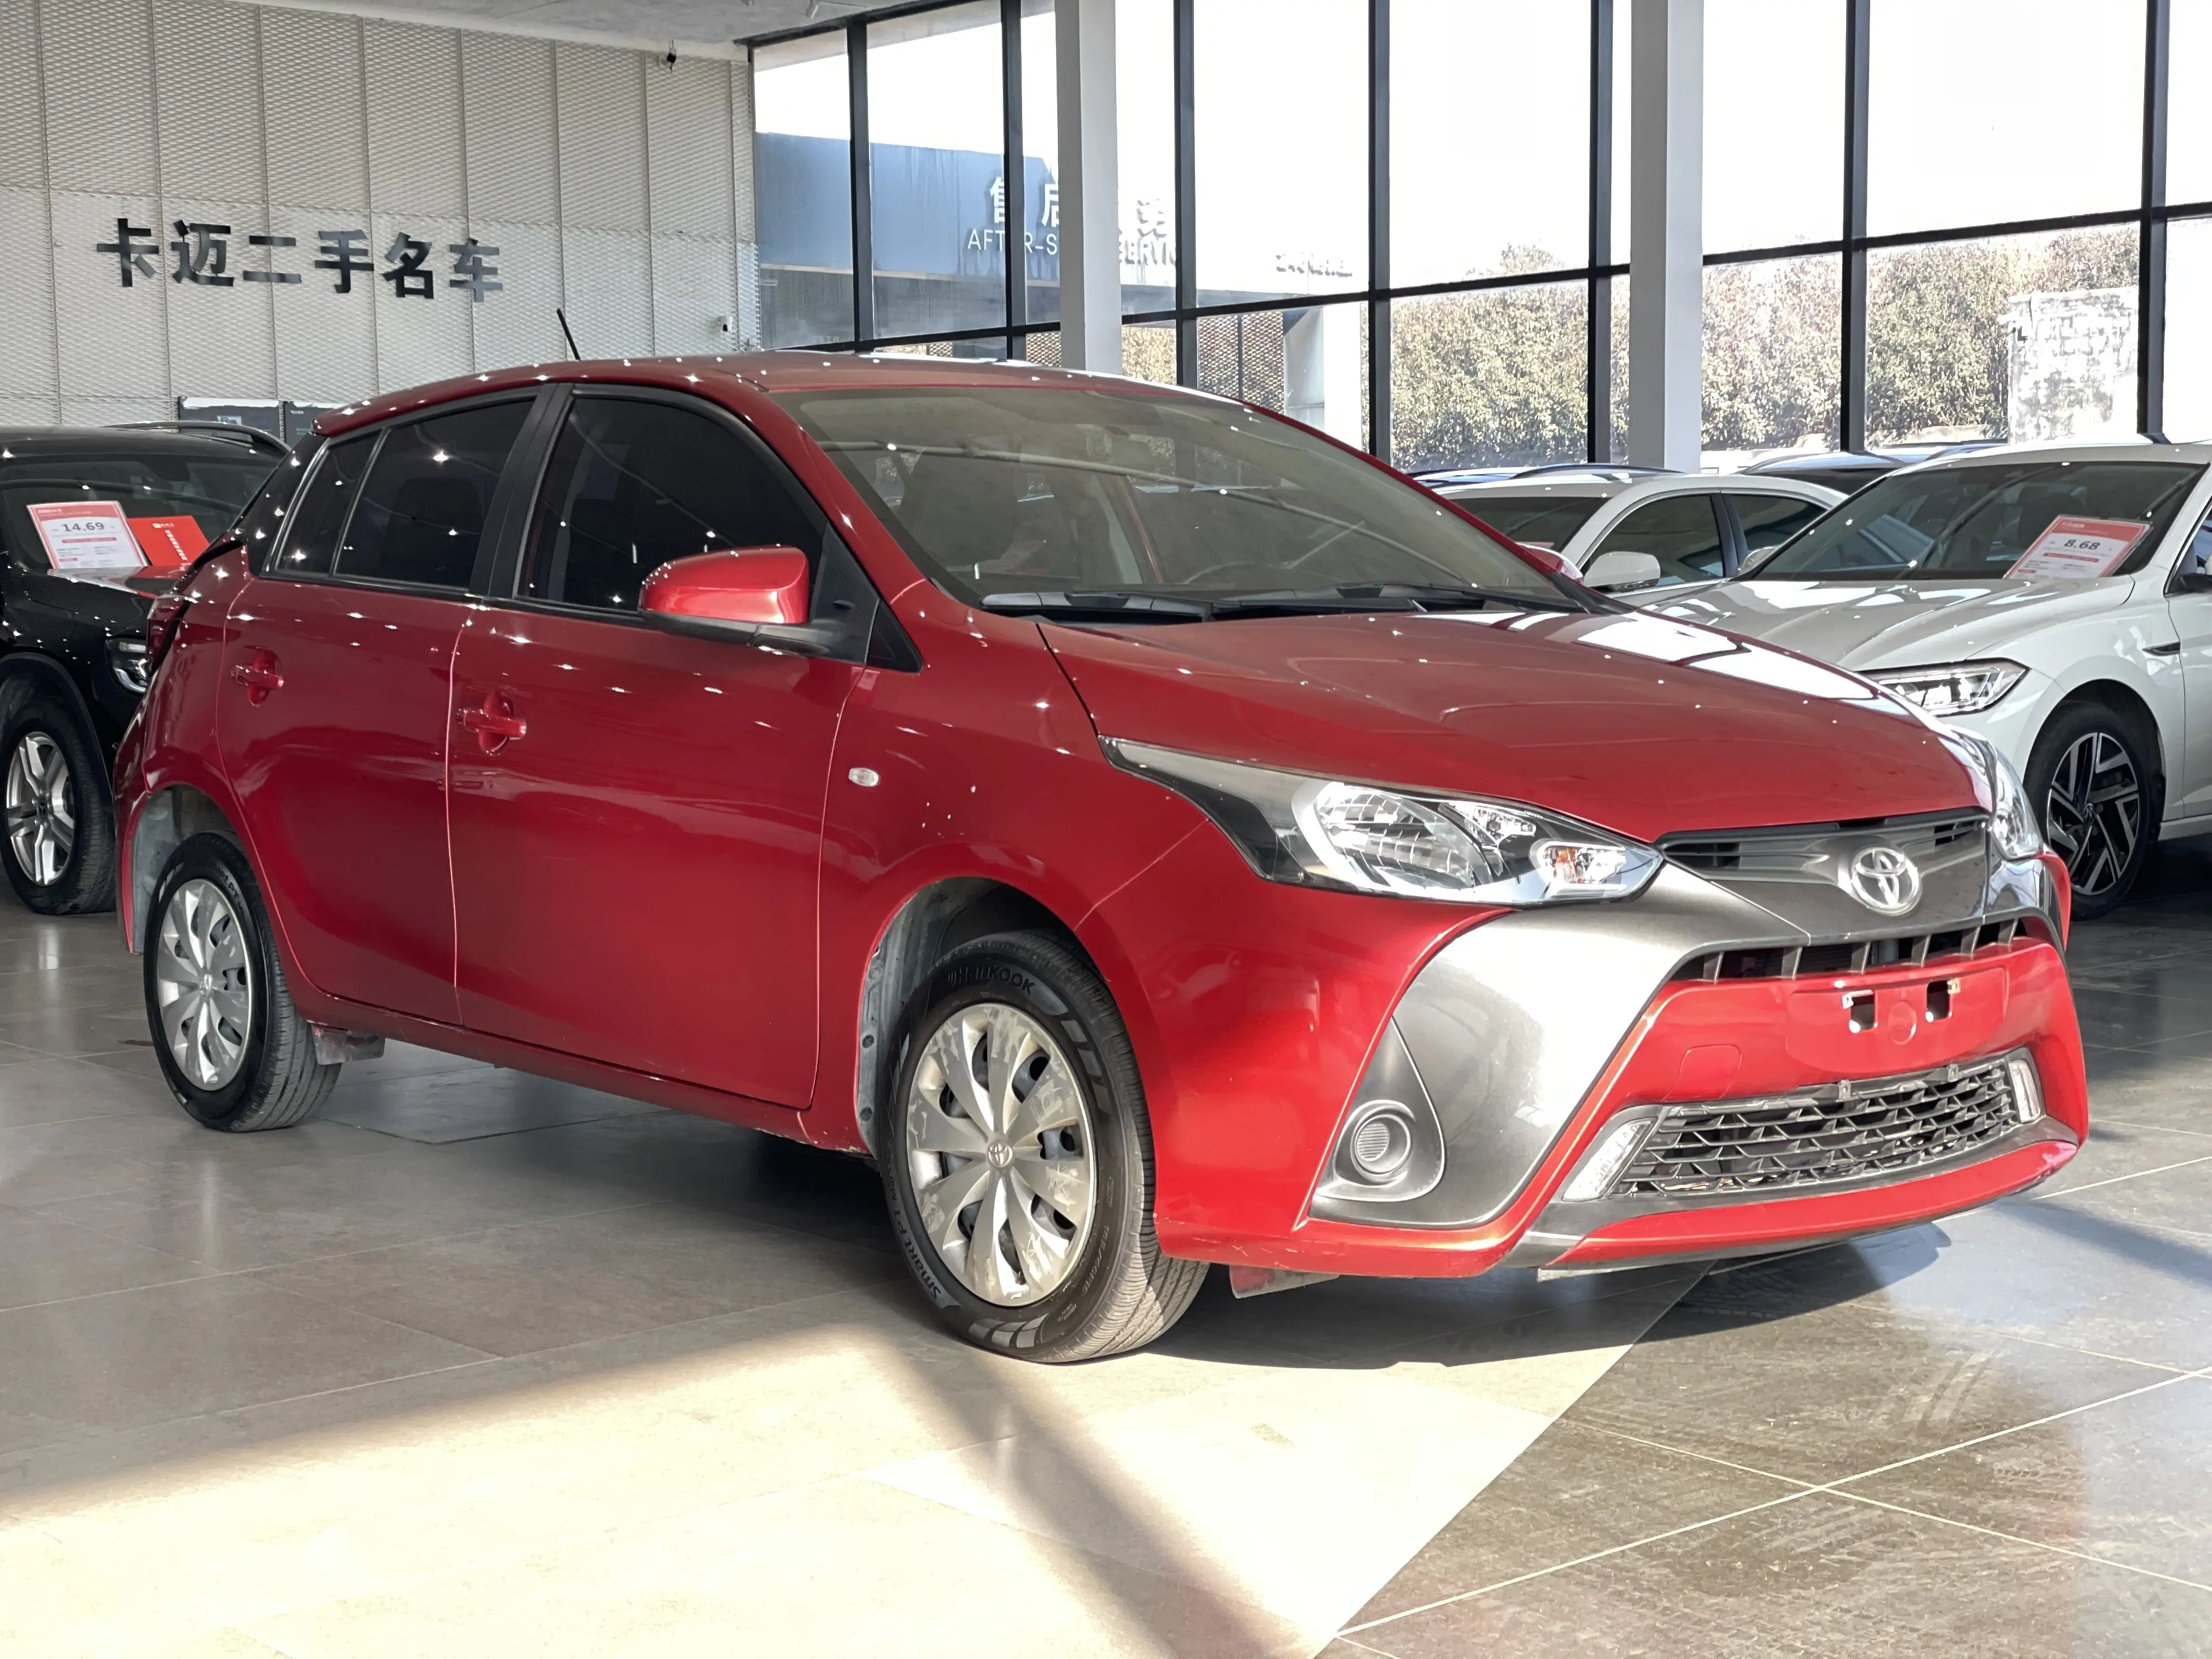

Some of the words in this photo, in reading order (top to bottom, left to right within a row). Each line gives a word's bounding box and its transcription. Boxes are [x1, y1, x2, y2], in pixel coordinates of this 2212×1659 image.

[97, 218, 503, 302] 卡迈二手名车
[61, 522, 104, 532] 14.69
[2064, 539, 2101, 550] 8.68
